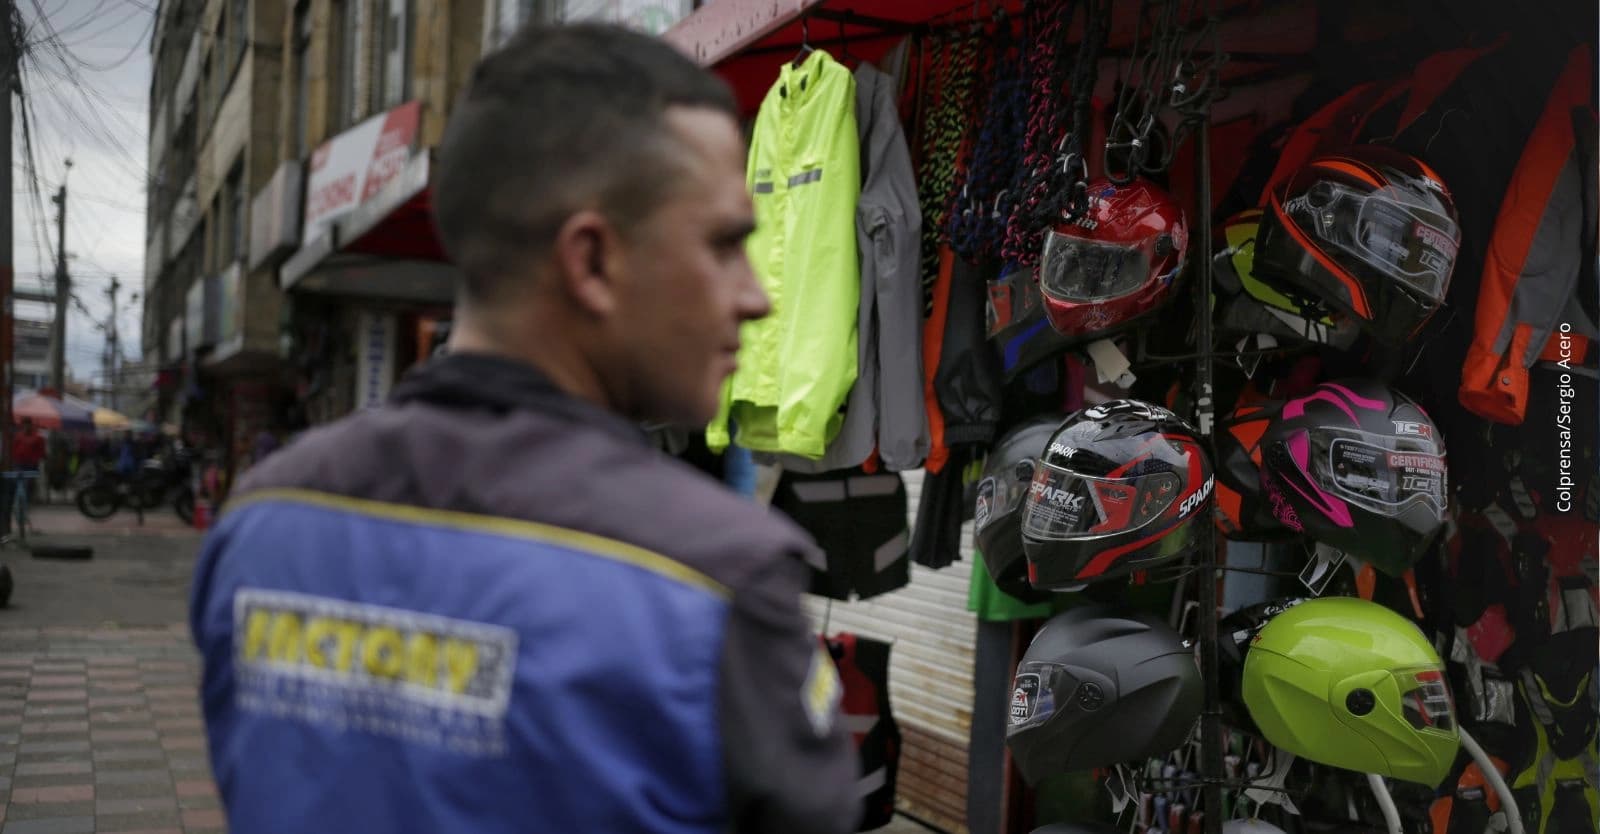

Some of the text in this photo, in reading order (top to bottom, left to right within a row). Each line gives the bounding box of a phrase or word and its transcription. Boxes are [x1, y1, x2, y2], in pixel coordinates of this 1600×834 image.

[1048, 442, 1078, 459] SPARK
[1030, 480, 1086, 508] SPARK
[244, 608, 478, 694] FACTORY
